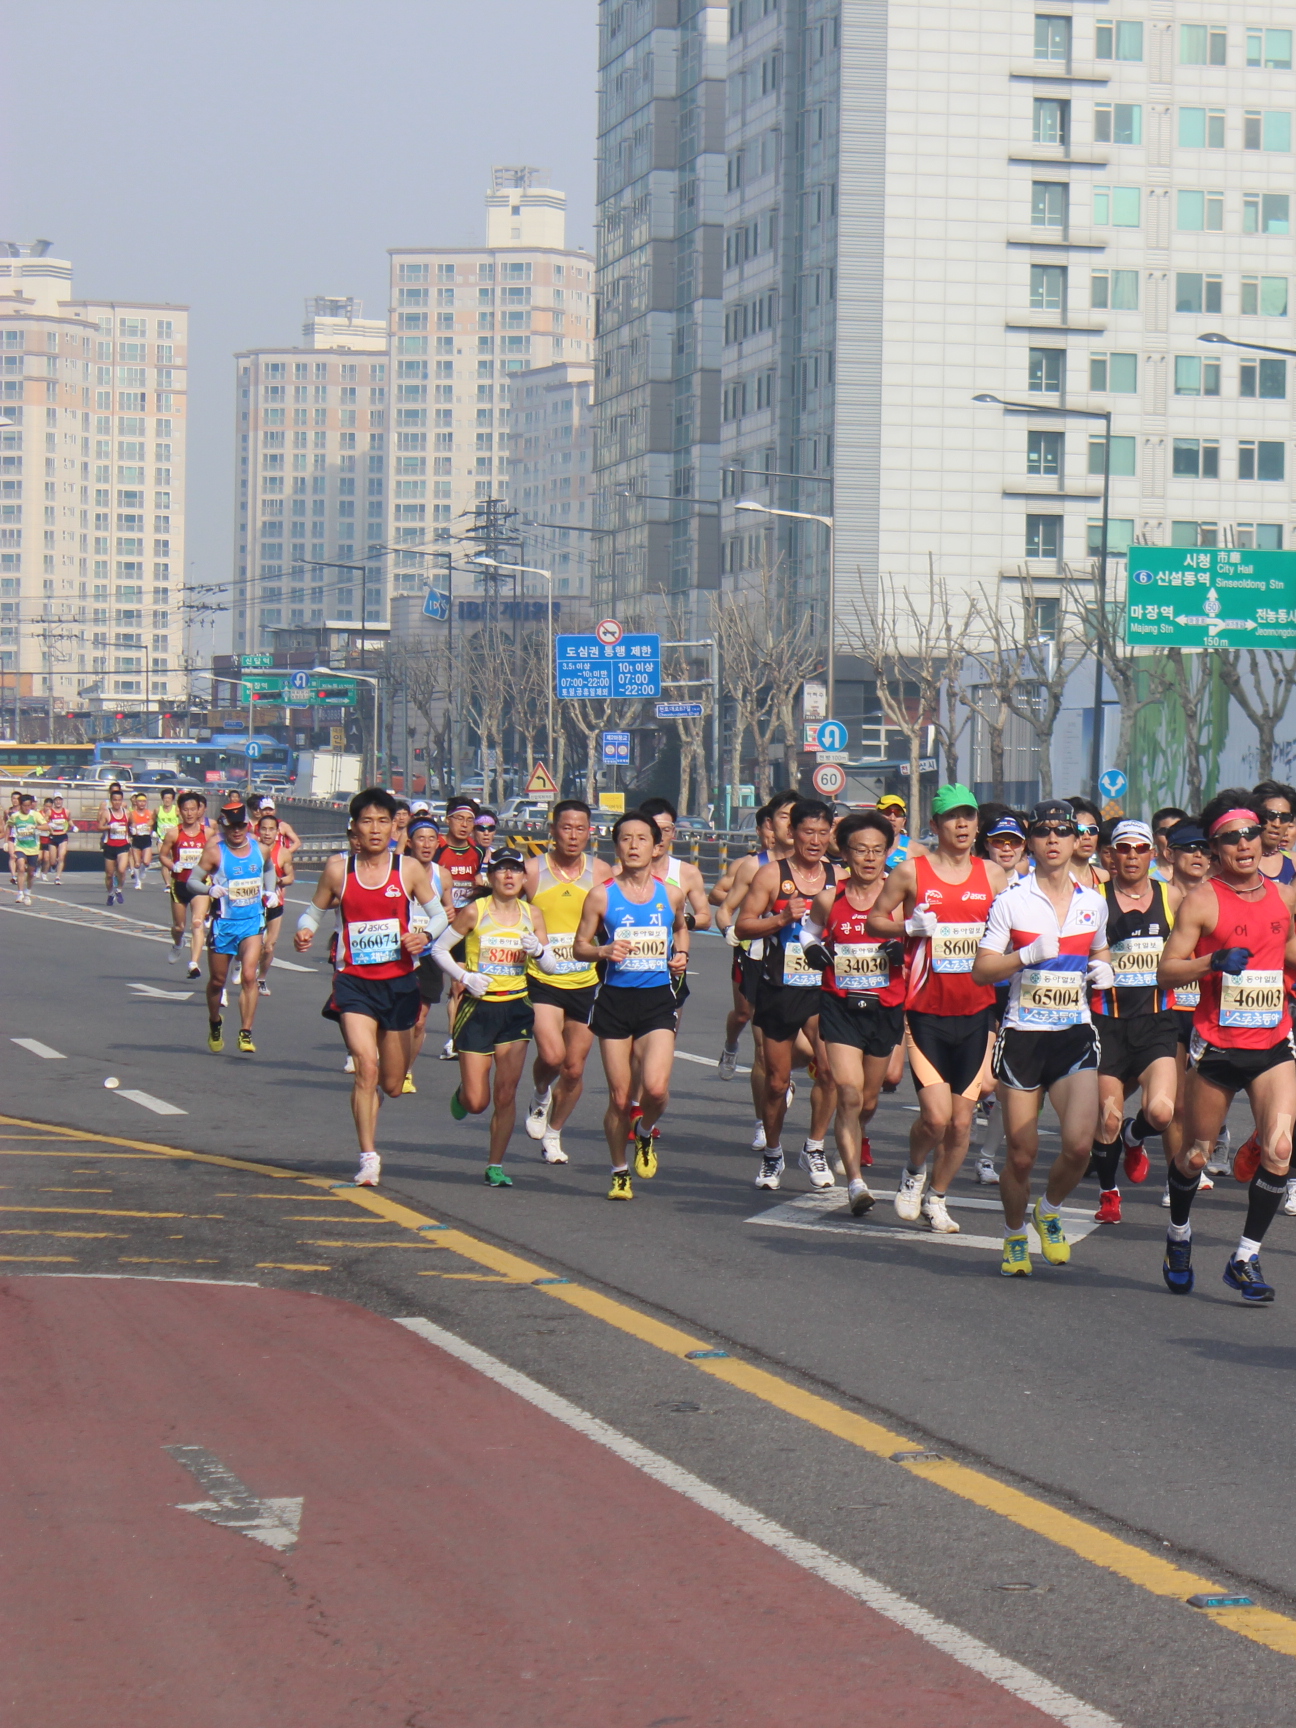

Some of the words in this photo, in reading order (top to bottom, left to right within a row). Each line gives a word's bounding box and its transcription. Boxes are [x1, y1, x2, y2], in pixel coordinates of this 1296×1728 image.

[1184, 553, 1210, 568] 시청
[1217, 564, 1234, 575] City
[1238, 565, 1254, 574] Hall
[1140, 572, 1148, 582] 6
[1156, 571, 1210, 586] 신설동역
[1216, 578, 1266, 591] Sinseoldong
[1269, 580, 1284, 589] Stn
[1130, 605, 1174, 620] 마장역
[1206, 601, 1218, 612] 50
[1130, 623, 1156, 635] Majang
[1160, 624, 1174, 634] Stn
[566, 646, 599, 658] 도심권
[604, 645, 625, 658] 통행
[630, 646, 652, 657] 제한
[618, 663, 633, 672] 10t
[636, 662, 653, 672] 이상
[593, 670, 607, 678] 미만
[618, 674, 648, 684] 07:00
[561, 678, 610, 687] 07:00~22:00
[619, 685, 654, 695] ~22:00
[821, 774, 837, 785] 60
[621, 914, 634, 927] 수
[649, 913, 661, 926] 지
[368, 923, 389, 932] asics
[841, 922, 852, 934] 광
[855, 922, 865, 935] 마
[953, 926, 981, 935] 동아일보
[1234, 924, 1248, 936] 어
[360, 933, 398, 949] 66074
[944, 940, 978, 956] 8600
[490, 948, 527, 963] 82002
[844, 958, 888, 974] 34030
[840, 976, 885, 988] 스포츠동아
[1032, 988, 1079, 1006] 65004
[1234, 989, 1280, 1008] 46003
[1024, 1010, 1078, 1023] 스포츠동아
[1226, 1012, 1279, 1025] 스포츠동아
